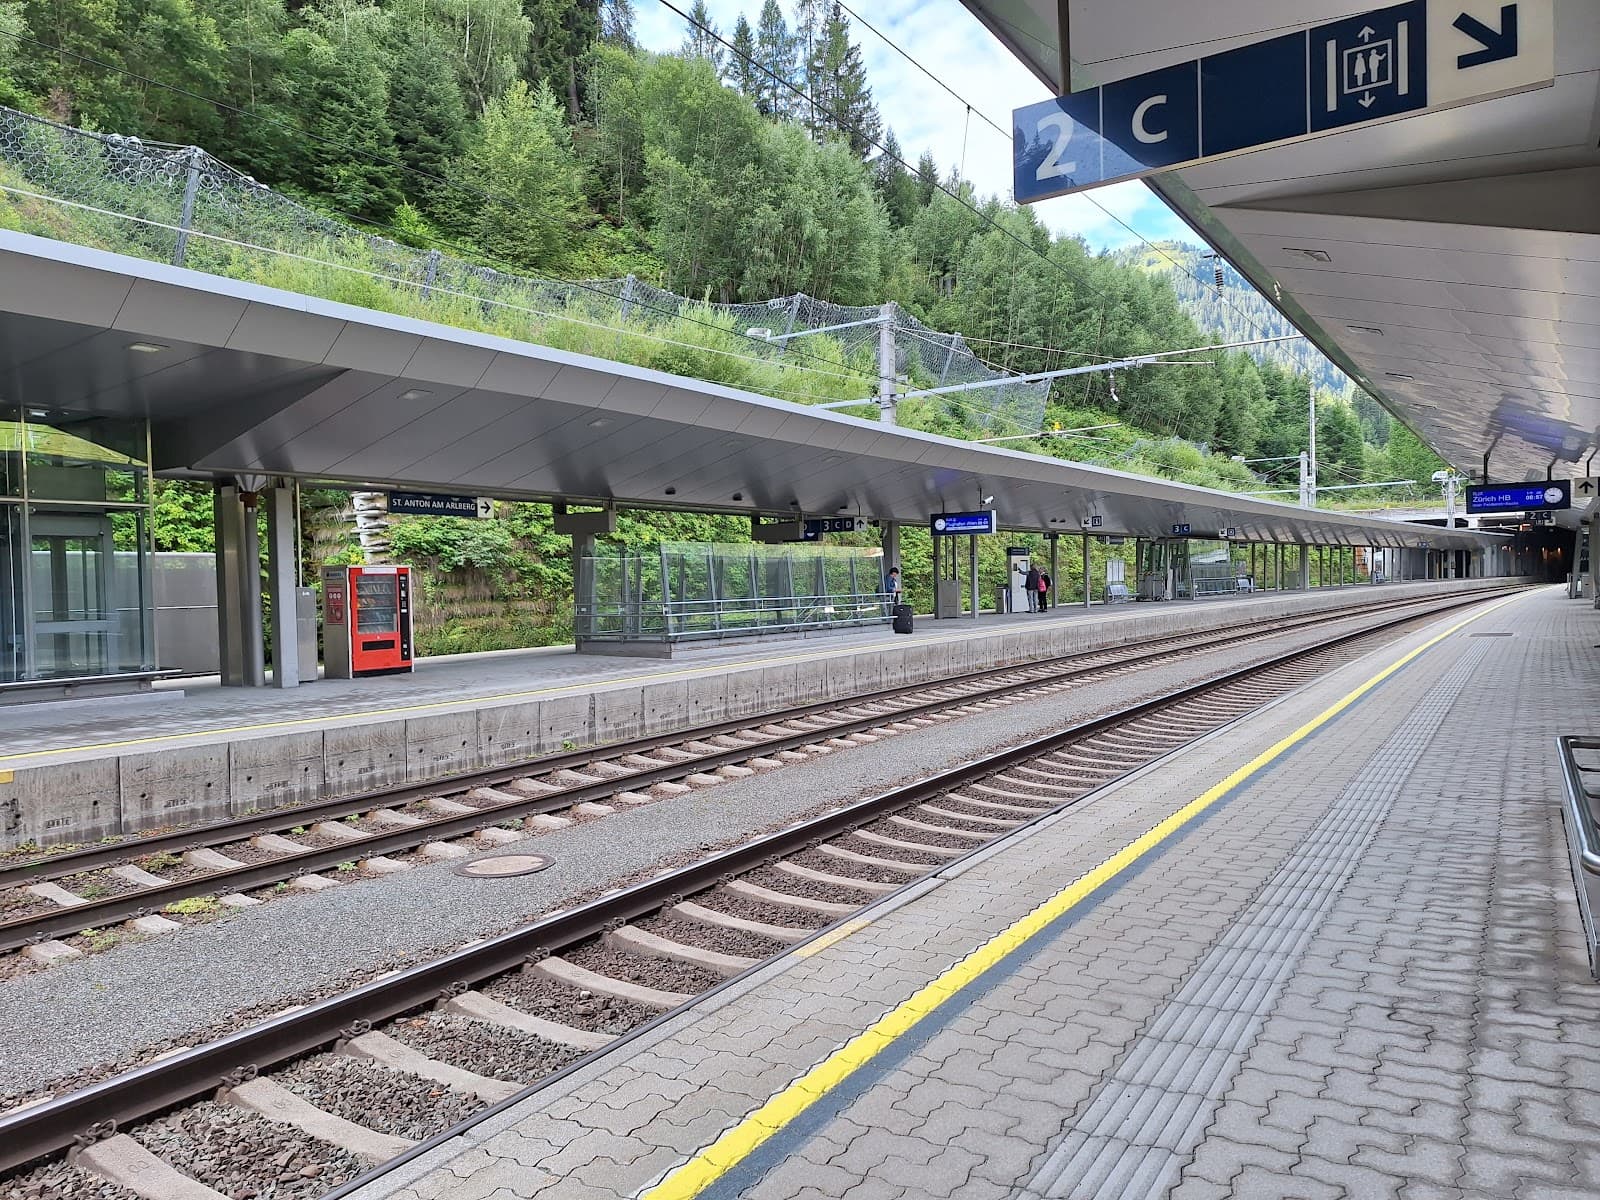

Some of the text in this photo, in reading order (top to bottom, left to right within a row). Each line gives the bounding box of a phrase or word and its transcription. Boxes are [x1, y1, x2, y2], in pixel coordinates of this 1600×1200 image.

[1035, 94, 1168, 181] 2 C
[392, 498, 476, 511] ST. ANTON AM ARLBERG
[1530, 512, 1537, 520] 2
[823, 520, 852, 531] 3 C D
[1174, 525, 1180, 533] 3
